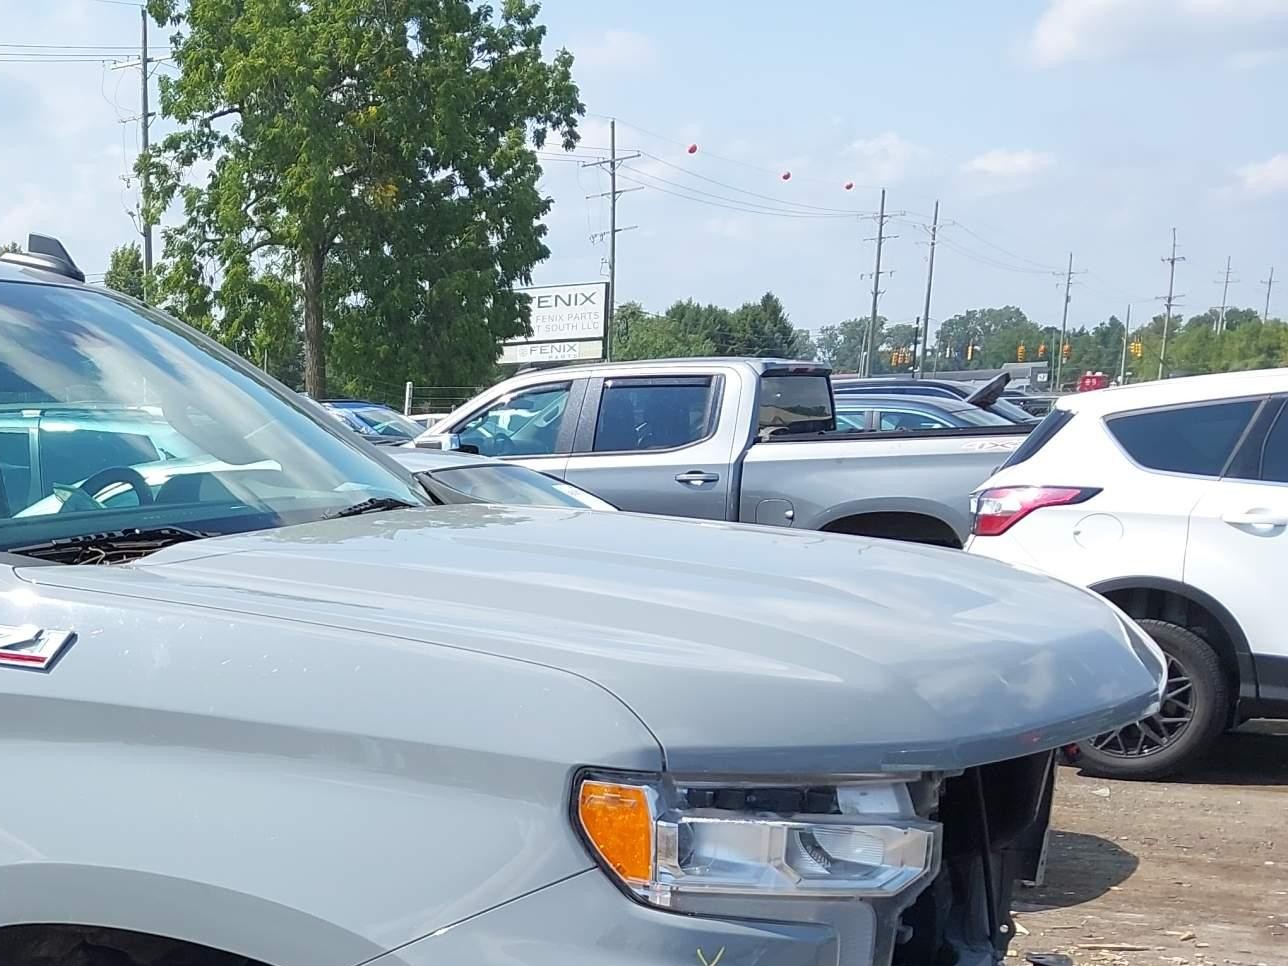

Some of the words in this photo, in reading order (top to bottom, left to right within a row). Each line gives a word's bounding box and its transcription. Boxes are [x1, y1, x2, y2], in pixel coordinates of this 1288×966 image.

[532, 291, 596, 308] ENIX
[536, 314, 564, 323] FENIX
[567, 311, 600, 321] PARTS
[545, 322, 577, 332] SOUTH
[581, 321, 599, 330] LLC
[530, 343, 577, 355] FENIX
